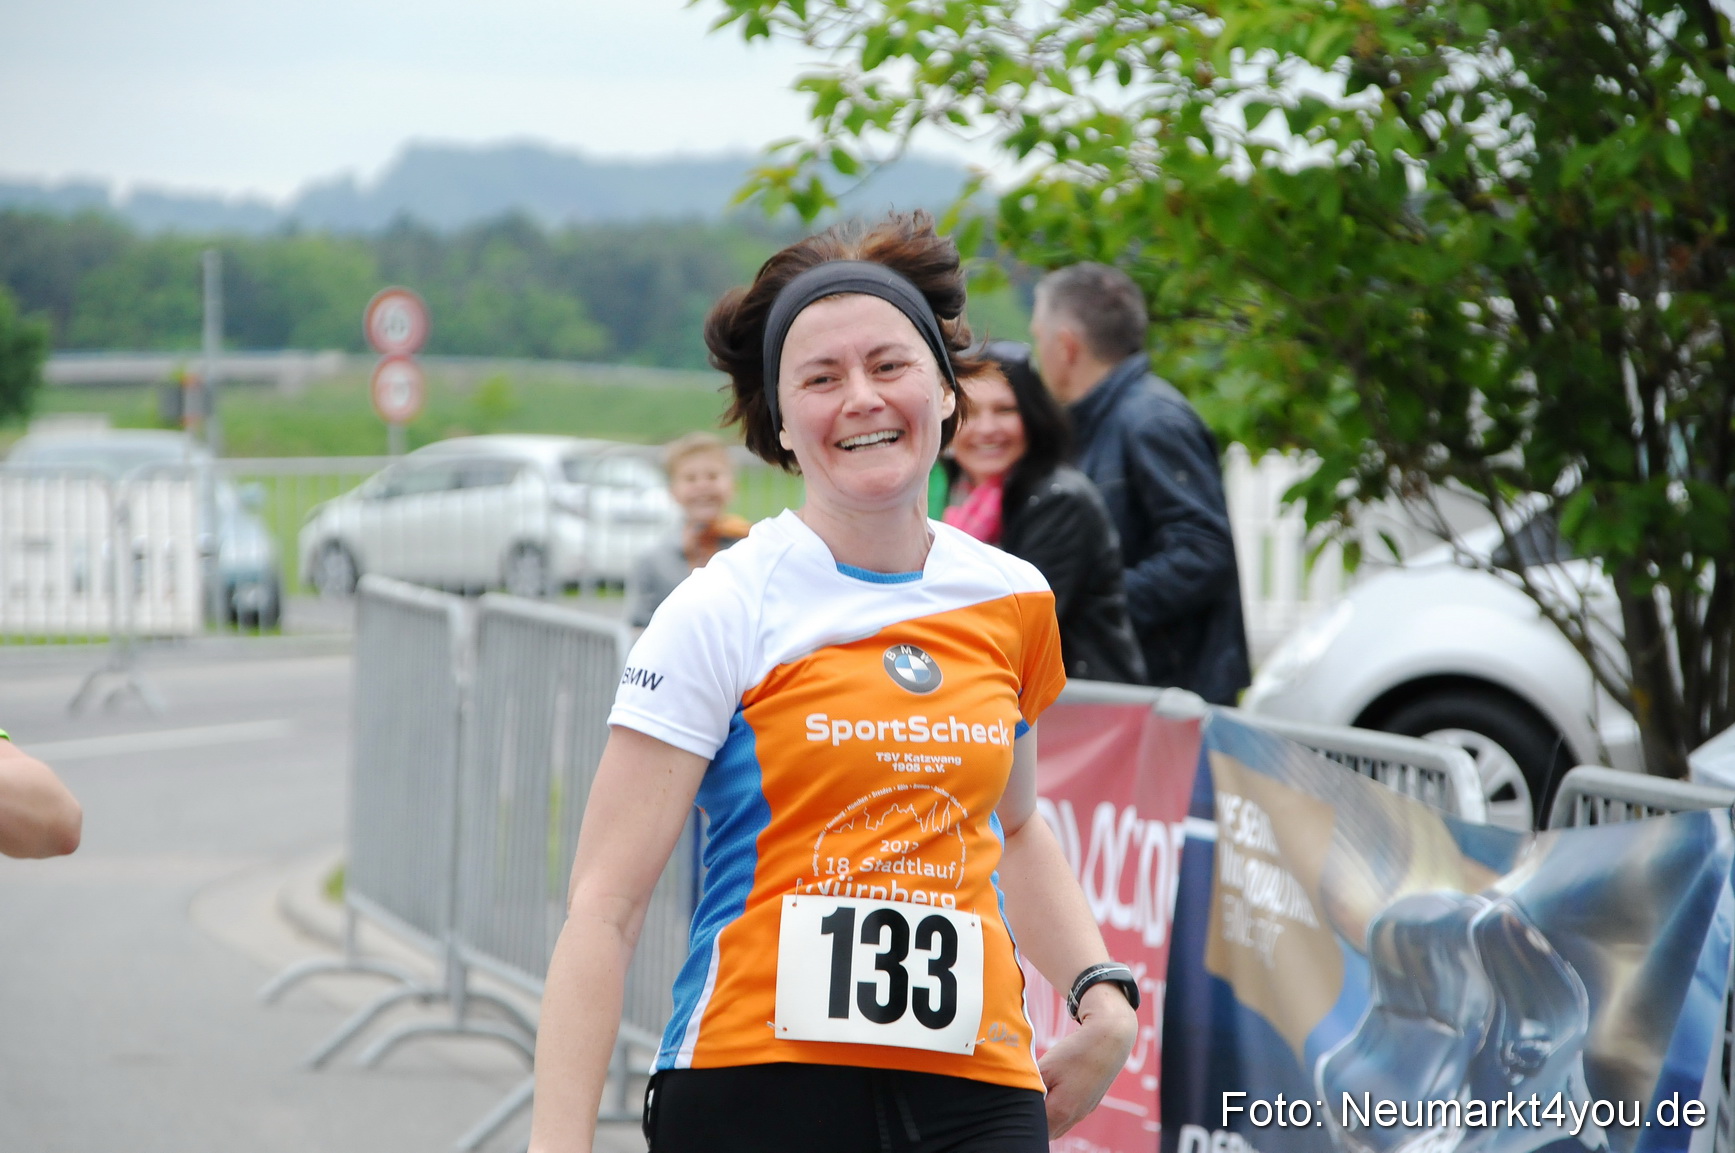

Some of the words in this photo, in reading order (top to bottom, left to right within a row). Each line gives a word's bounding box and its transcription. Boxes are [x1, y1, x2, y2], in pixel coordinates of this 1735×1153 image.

[885, 645, 931, 664] BMW
[621, 667, 664, 691] BMW
[805, 712, 1010, 747] SportScheck
[875, 751, 901, 762] TSV
[904, 752, 962, 766] Katzwang
[891, 762, 921, 773] 1905
[825, 856, 850, 876] 18
[859, 856, 956, 880] Stadtlauf
[820, 906, 958, 1030] 133
